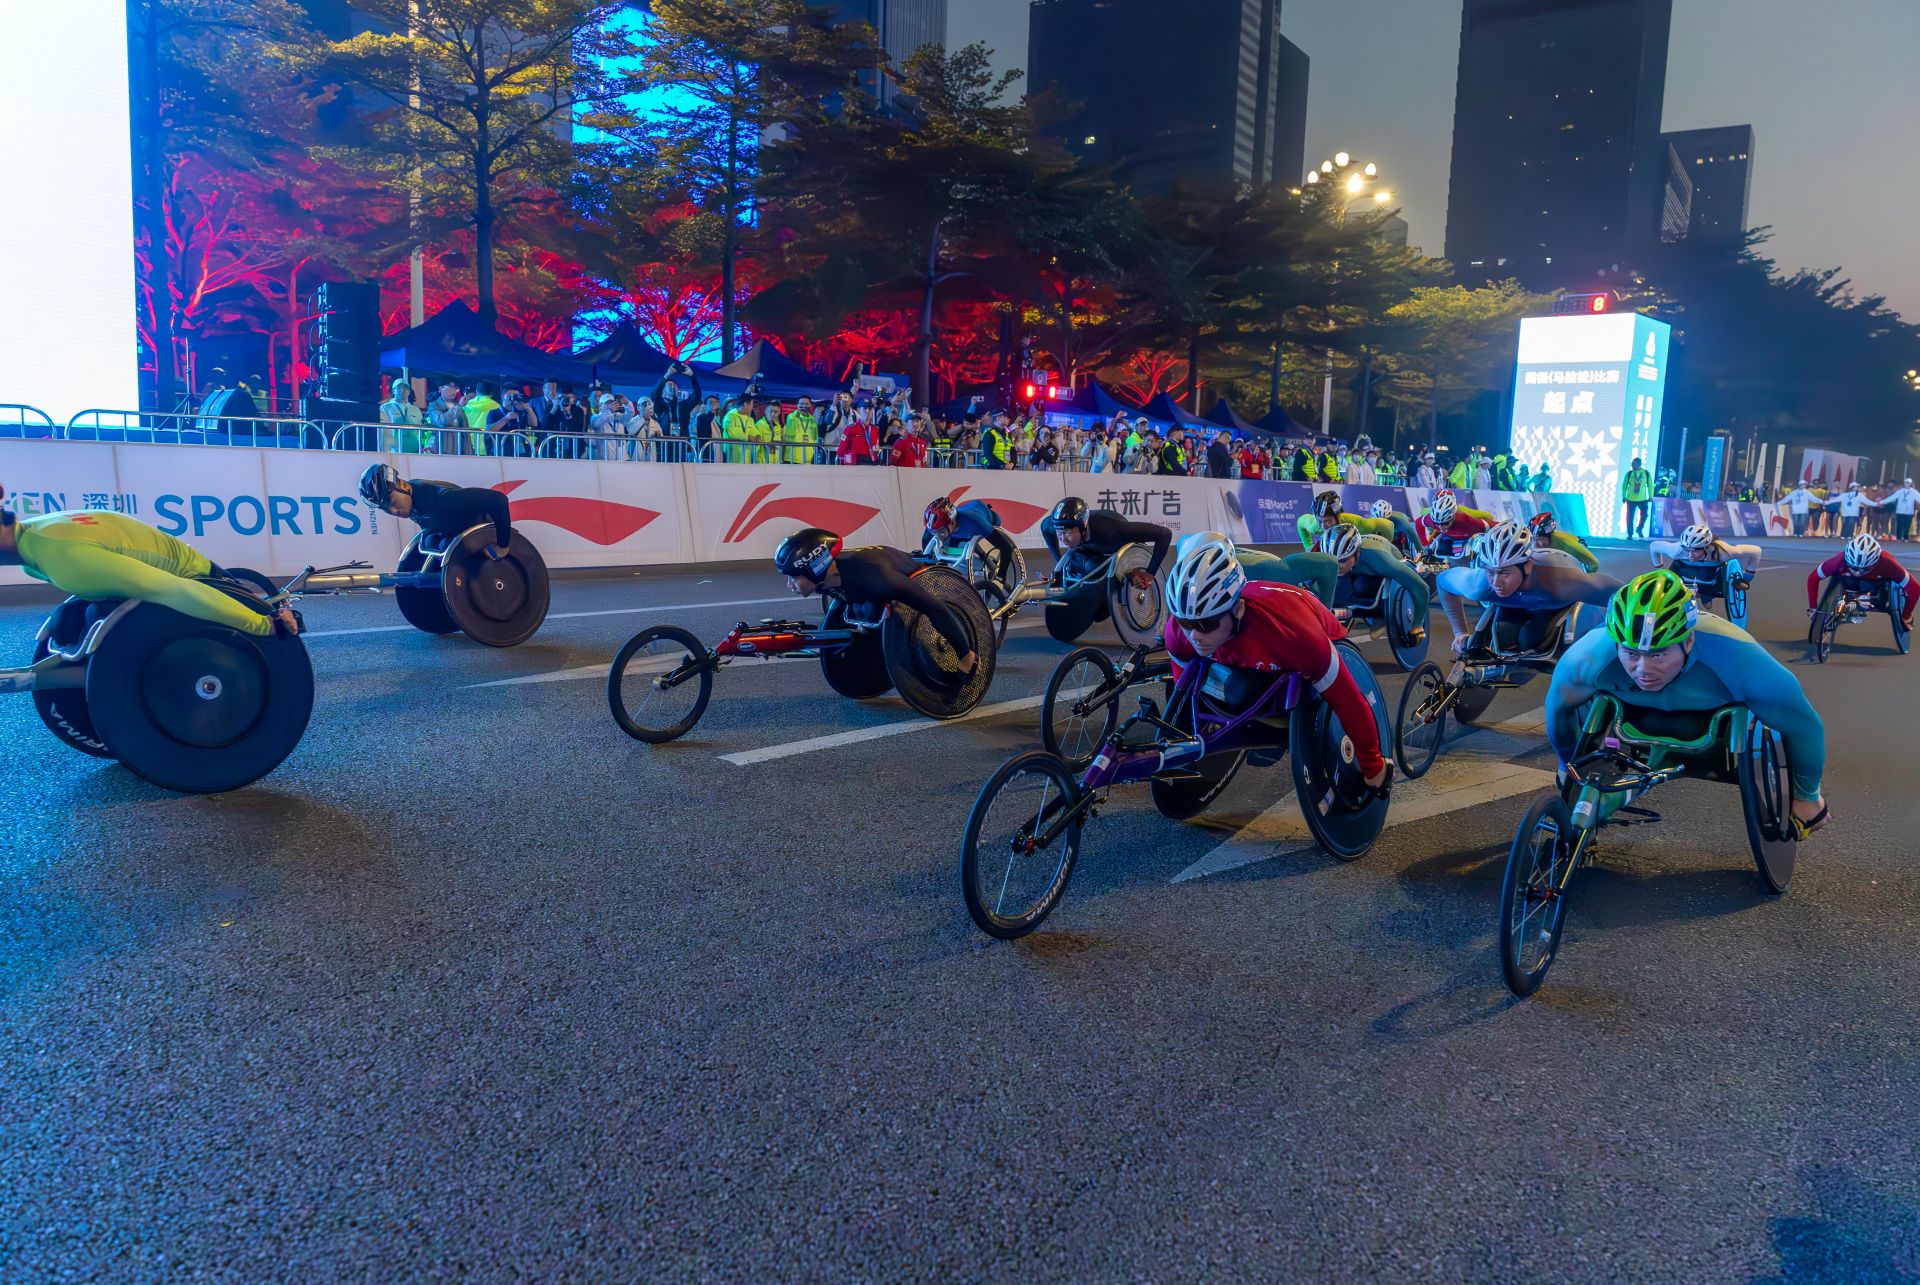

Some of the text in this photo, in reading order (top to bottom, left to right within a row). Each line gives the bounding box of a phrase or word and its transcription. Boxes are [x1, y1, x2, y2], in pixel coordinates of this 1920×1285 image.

[1542, 391, 1595, 414] 起点
[82, 493, 138, 515] 深圳
[154, 494, 361, 537] SPORTS
[1097, 489, 1181, 516] 未来广告
[793, 540, 828, 569] RUDY
